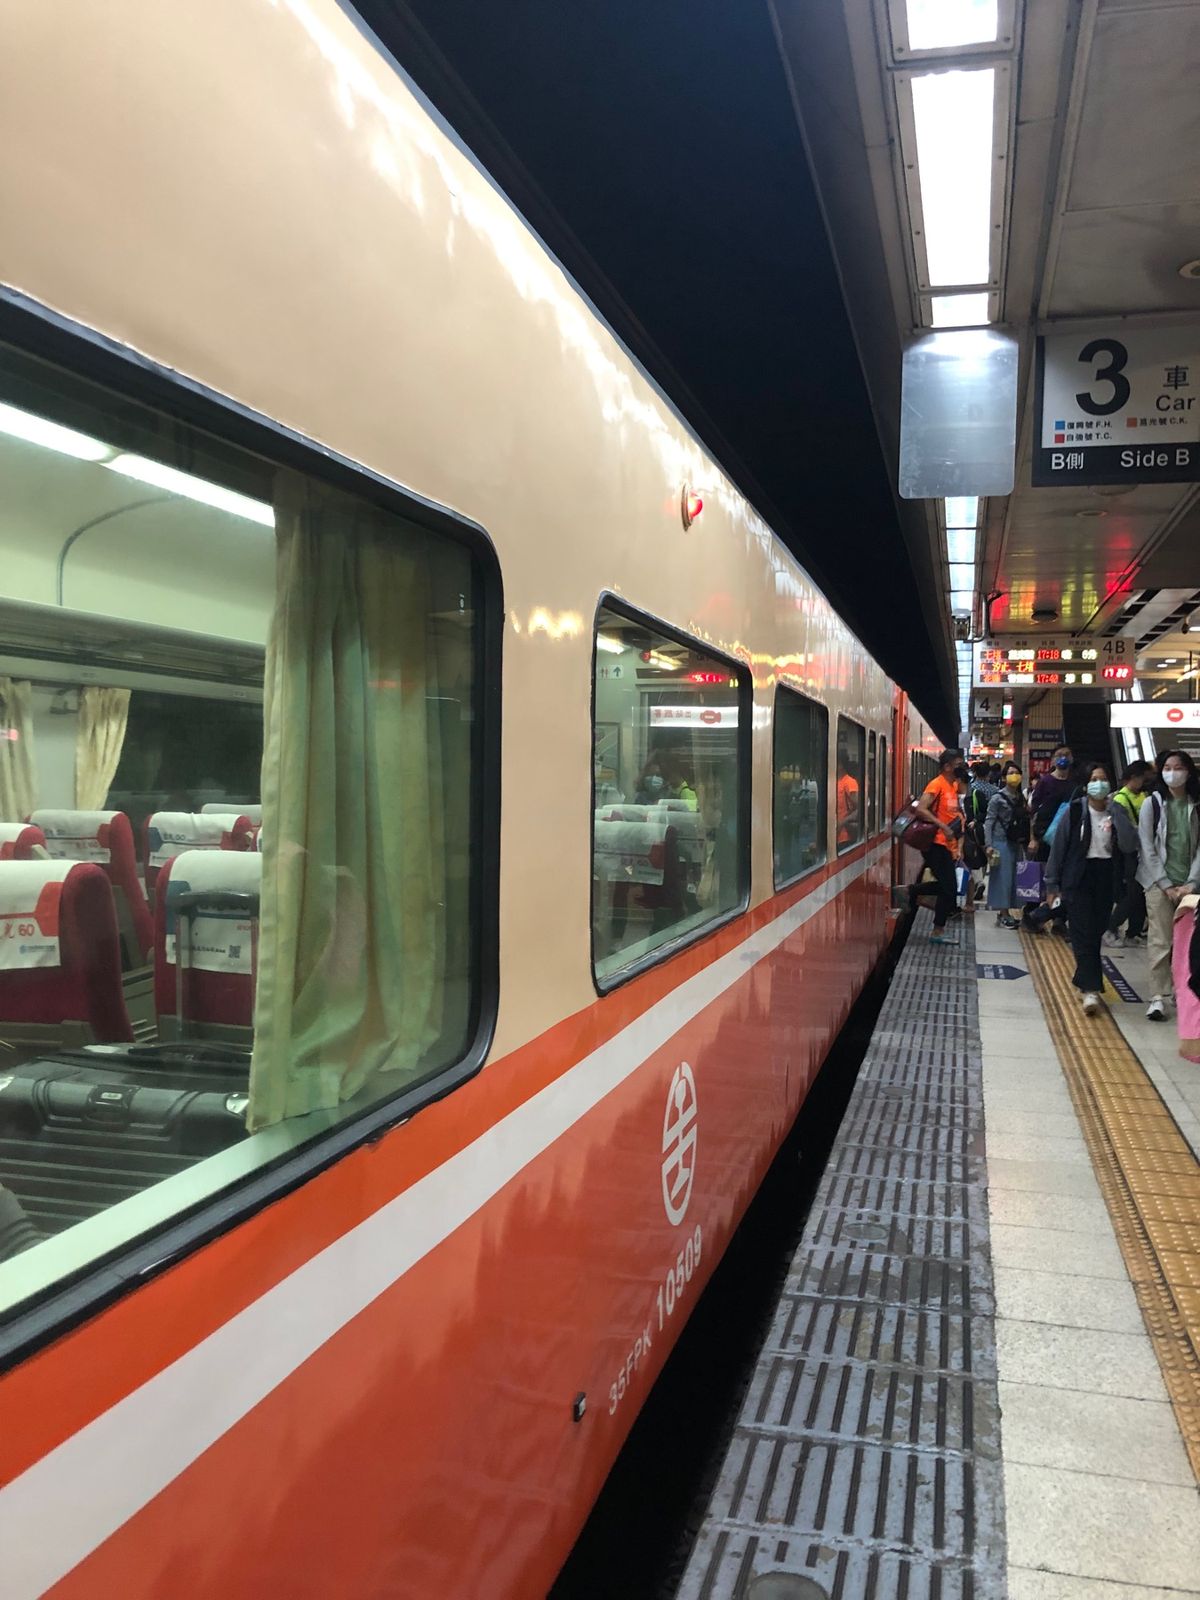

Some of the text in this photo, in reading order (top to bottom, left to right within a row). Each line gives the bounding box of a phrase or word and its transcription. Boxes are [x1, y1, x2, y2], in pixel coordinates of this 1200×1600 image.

[1075, 338, 1131, 416] 3
[1162, 365, 1190, 390] 車
[1155, 394, 1196, 412] Car
[1051, 452, 1085, 470] B側
[1120, 449, 1190, 468] Side B
[1037, 650, 1060, 660] 17:18
[1103, 640, 1126, 654] 4B
[980, 697, 990, 711] 4
[657, 1224, 702, 1331] 10509
[609, 1319, 652, 1416] 35FPK
